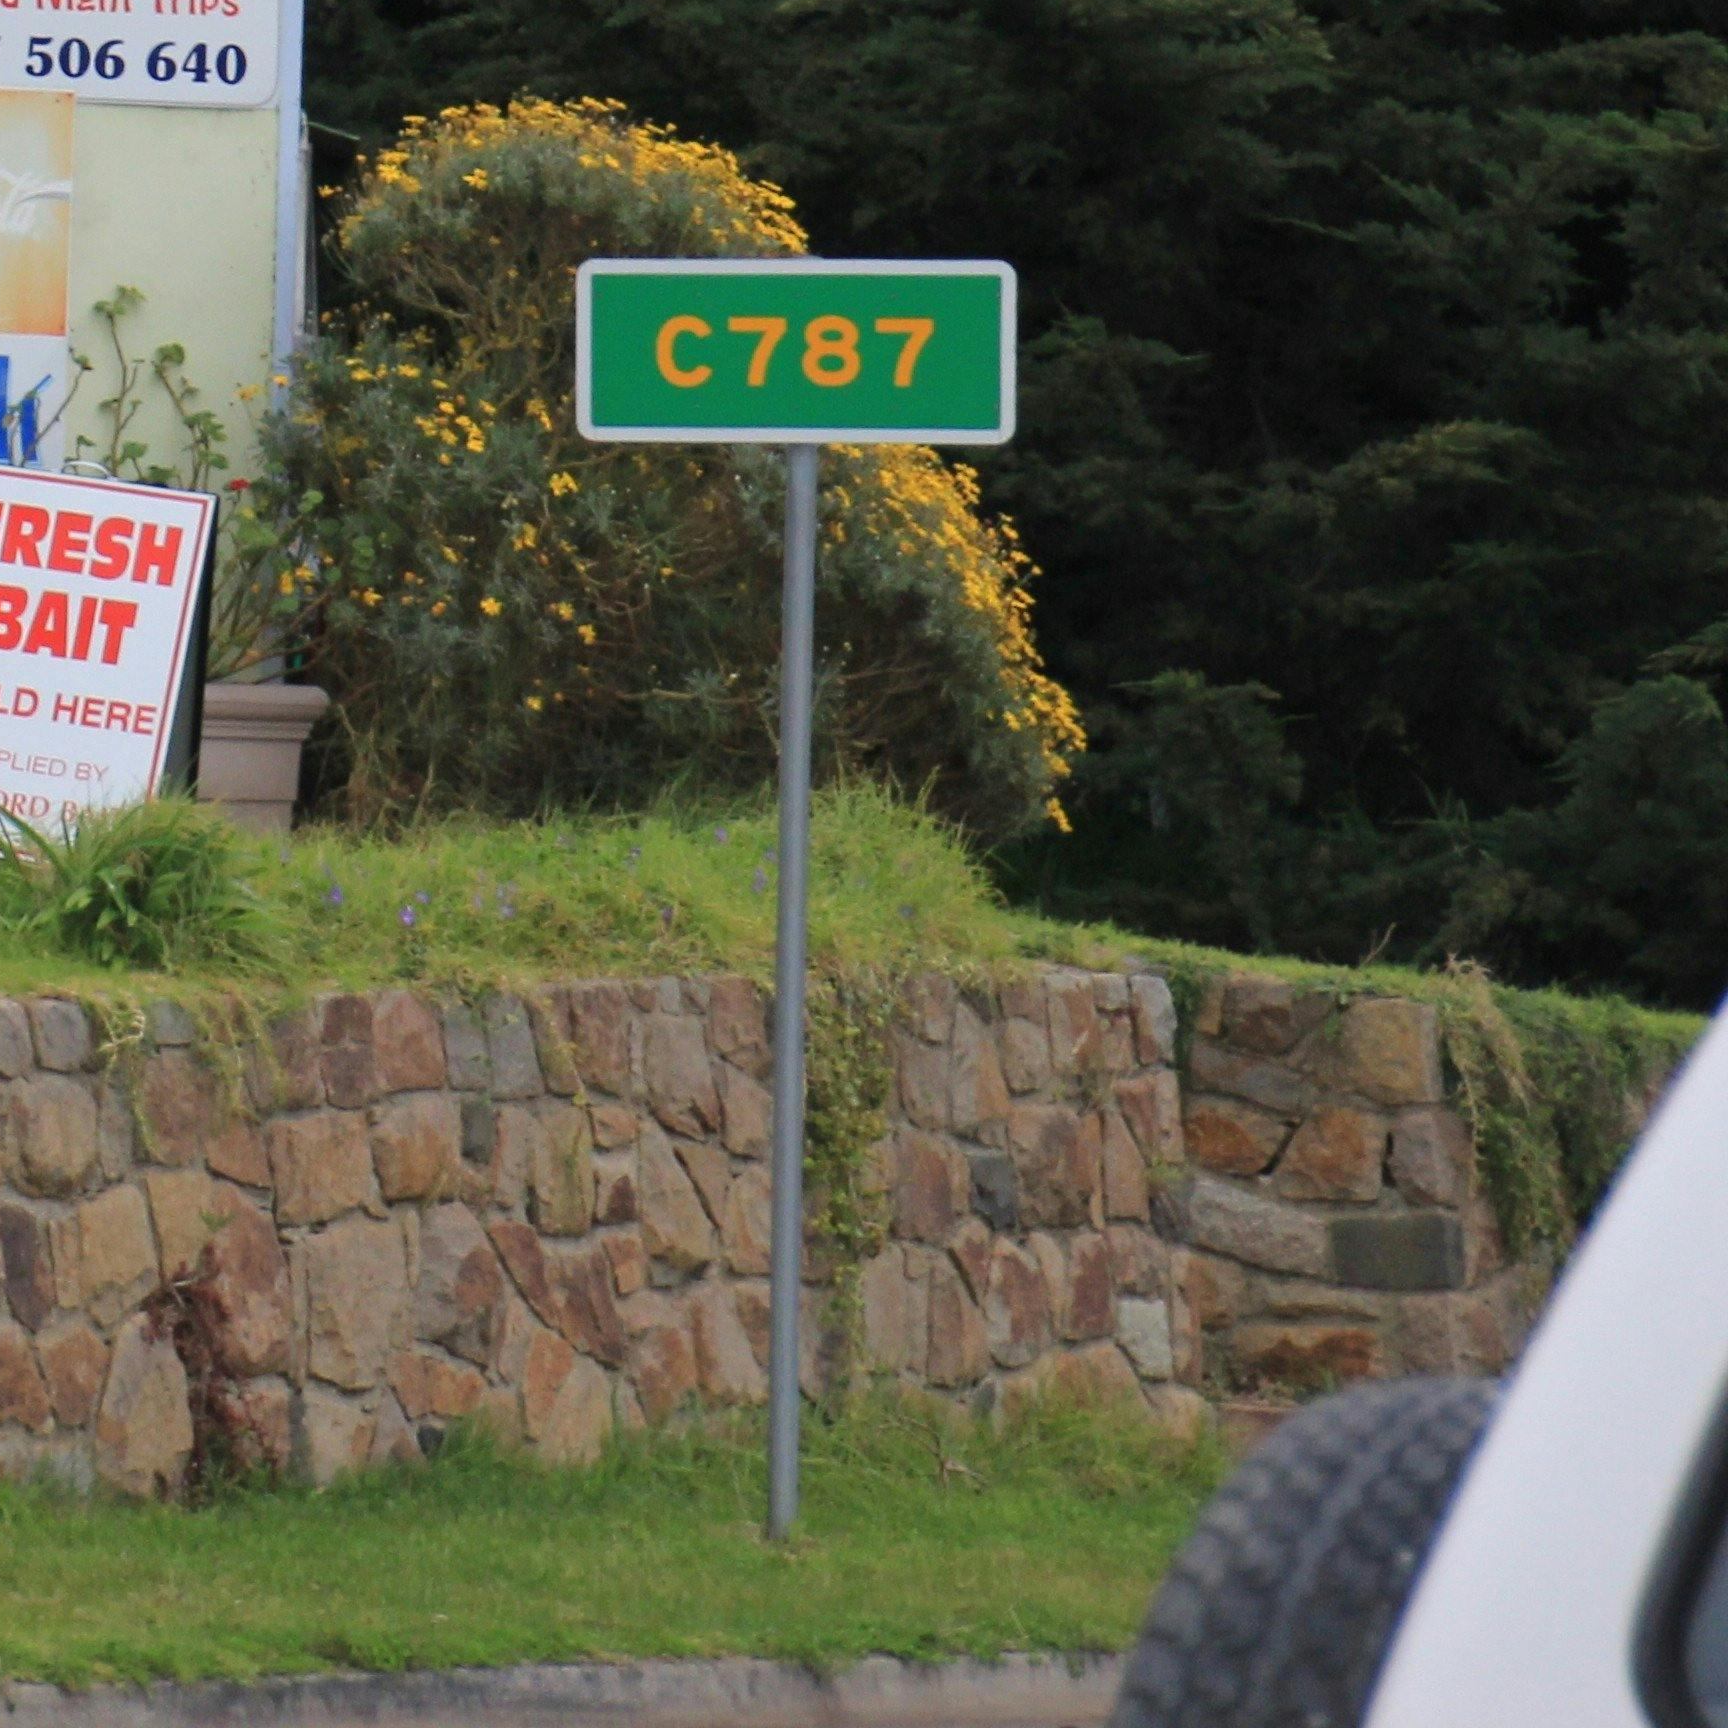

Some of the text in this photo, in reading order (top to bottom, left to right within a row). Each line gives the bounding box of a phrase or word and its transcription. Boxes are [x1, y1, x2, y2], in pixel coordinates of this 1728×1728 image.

[24, 37, 125, 81] 506
[146, 41, 248, 86] 640
[655, 313, 935, 388] C787
[51, 692, 158, 736] HERE
[74, 761, 110, 782] BY
